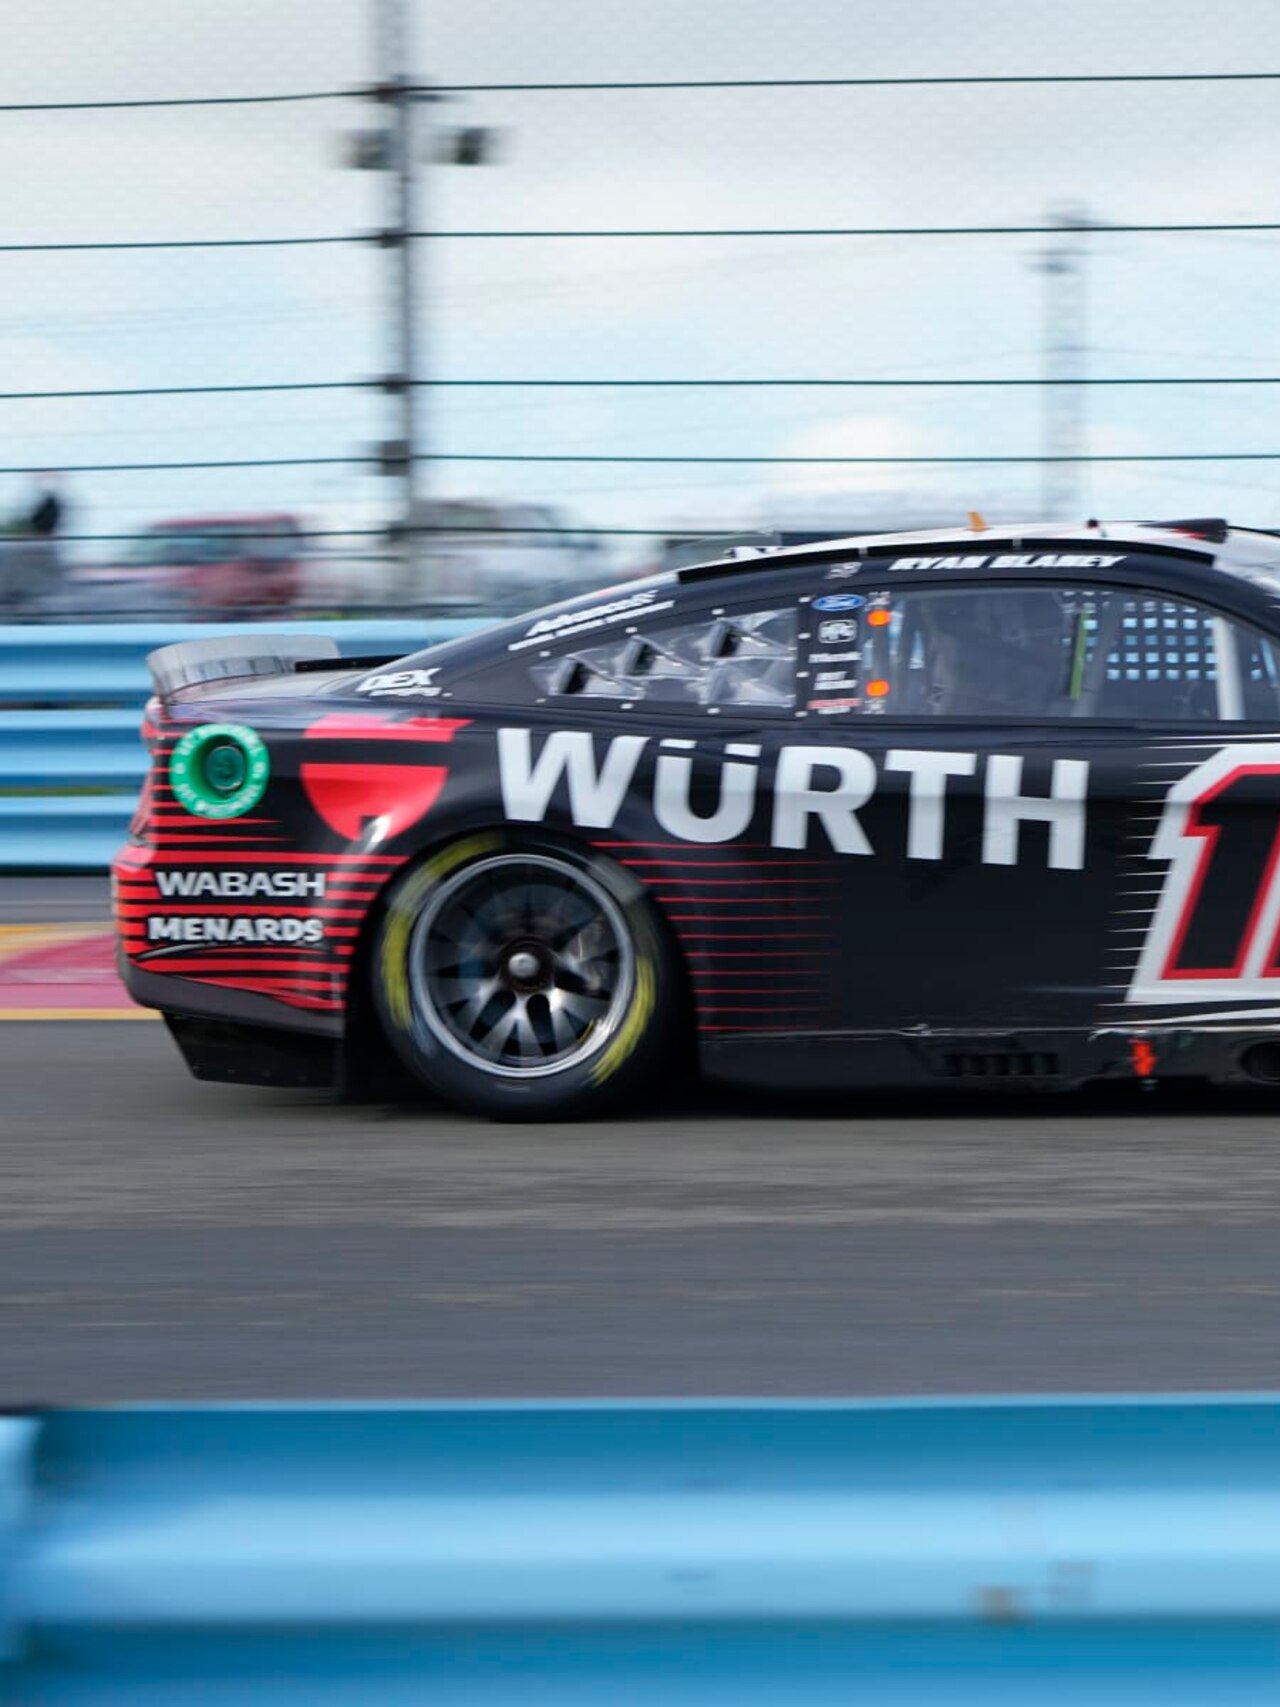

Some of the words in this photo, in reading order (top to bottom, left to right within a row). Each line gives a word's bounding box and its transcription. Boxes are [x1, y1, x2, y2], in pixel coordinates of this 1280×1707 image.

[888, 556, 989, 571] RYAN
[989, 554, 1127, 568] BLANEY
[497, 728, 1090, 871] WÜRTH
[155, 871, 325, 897] WABASH
[147, 916, 324, 942] MENARDS
